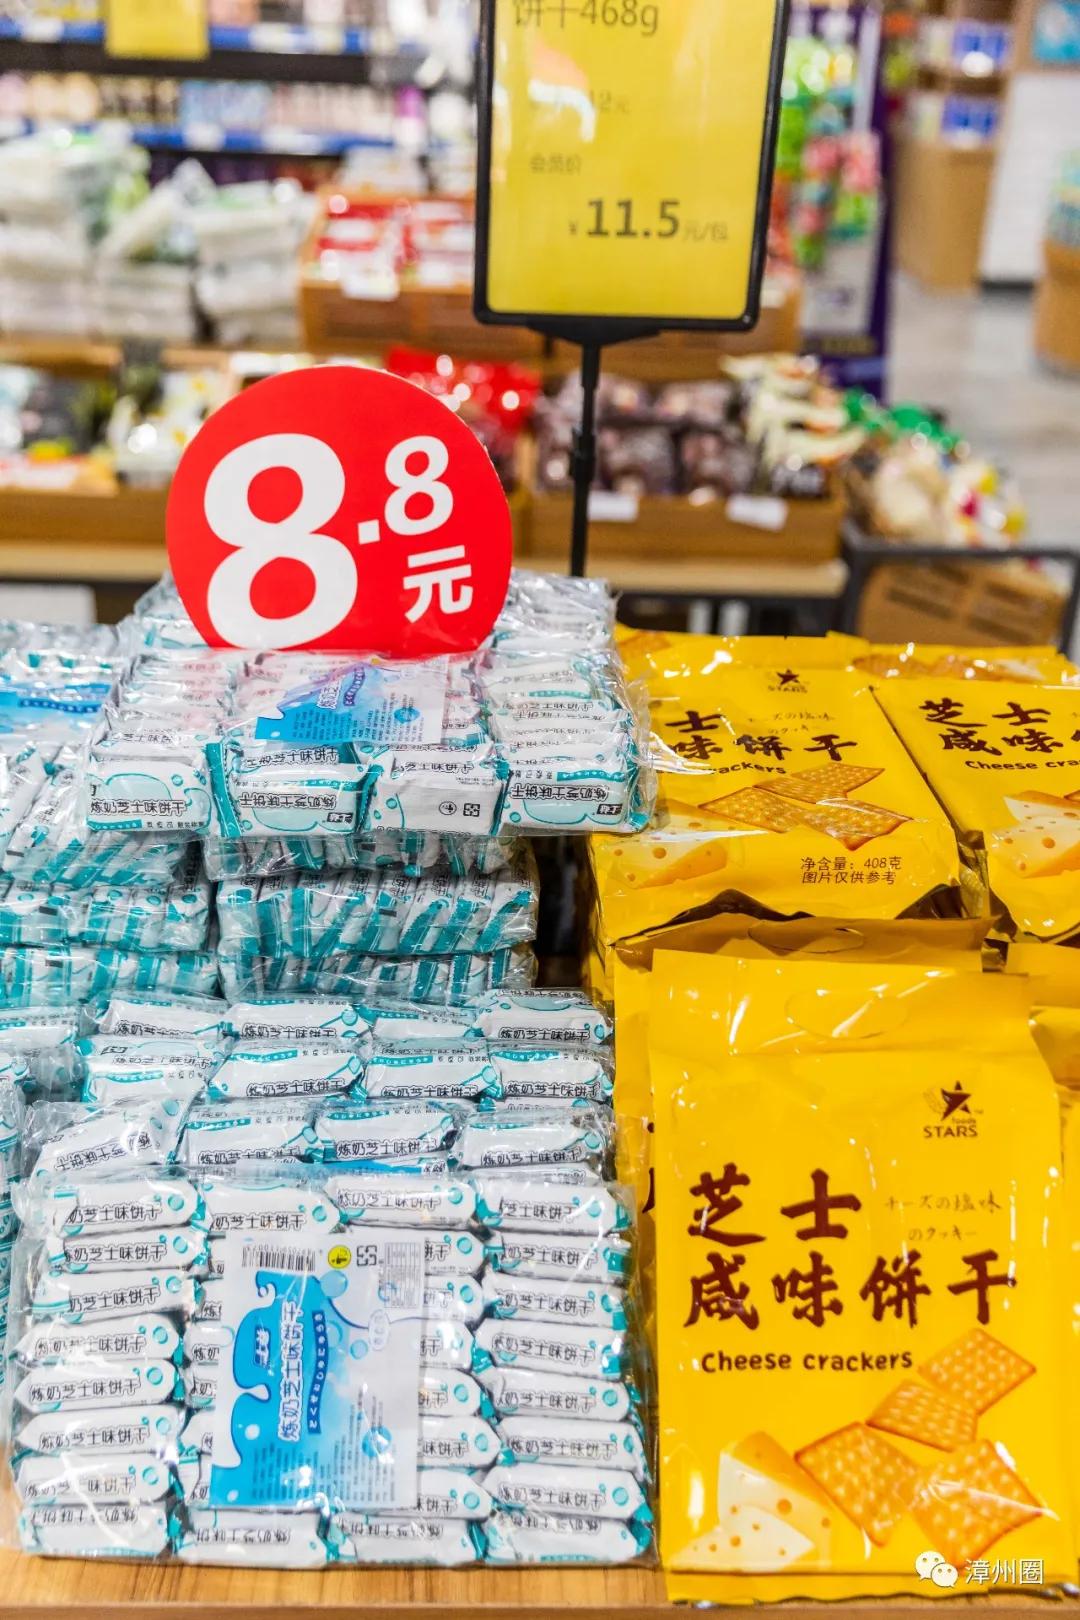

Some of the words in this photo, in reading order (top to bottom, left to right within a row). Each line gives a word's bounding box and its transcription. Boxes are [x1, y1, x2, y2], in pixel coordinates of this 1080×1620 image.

[204, 433, 454, 650] 8.8
[403, 545, 473, 624] 元
[919, 697, 1052, 728] 芝士
[939, 728, 1080, 756] 咸味
[965, 760, 1038, 770] Cheese
[240, 793, 335, 809] 炼奶芝士味饼干
[512, 786, 607, 800] 炼奶芝士味饼干
[90, 801, 187, 815] 炼奶芝士味饼干
[802, 871, 897, 885] 图片仅供参考
[501, 1029, 589, 1041] 炼奶芝士味饼干
[923, 1125, 978, 1138] STARS
[501, 1203, 573, 1219] 芝士味饼
[687, 1162, 862, 1248] 芝士
[683, 1248, 1017, 1332] 咸味饼干
[282, 1303, 302, 1439] 炼奶芝士味饼干
[702, 1351, 792, 1374] Cheese
[803, 1350, 914, 1371] crackers
[26, 1478, 134, 1496] 炼芝味饼干
